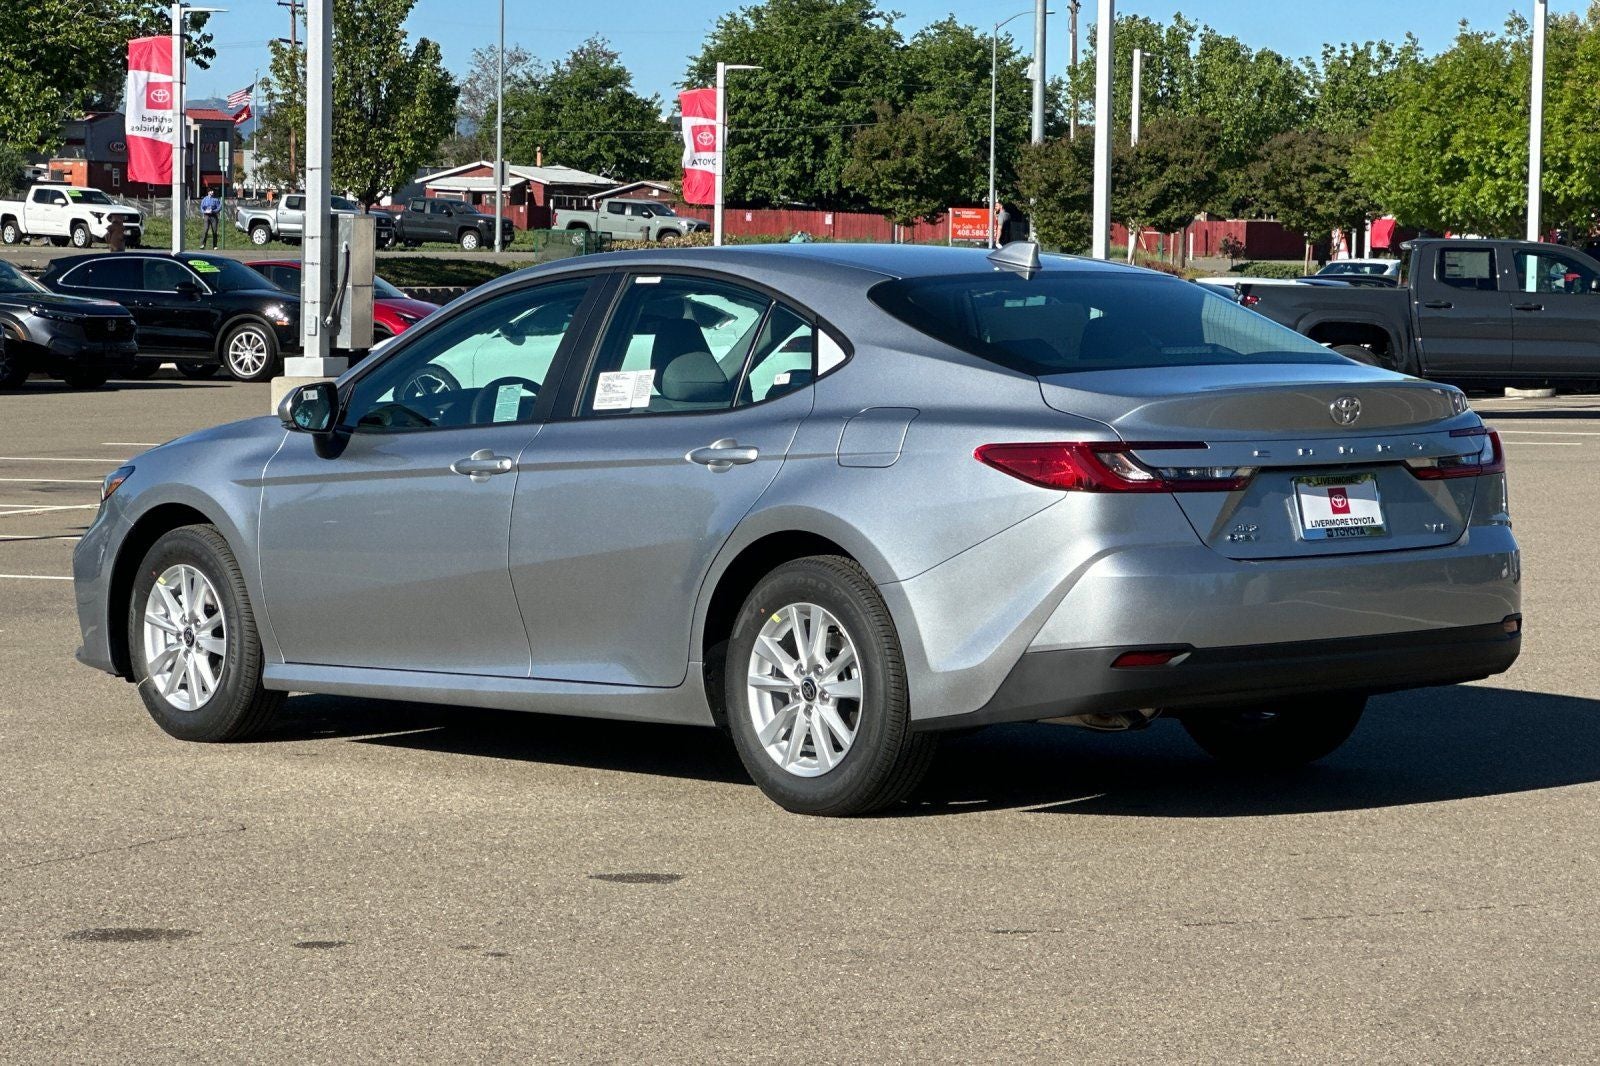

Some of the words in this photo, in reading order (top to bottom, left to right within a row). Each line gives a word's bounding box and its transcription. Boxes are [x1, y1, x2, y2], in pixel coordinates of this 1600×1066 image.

[1317, 476, 1354, 485] LIVERMORE
[1310, 518, 1349, 528] LIVERMORE
[1350, 516, 1376, 526] TOYOTA
[1335, 526, 1366, 537] TOYOTA
